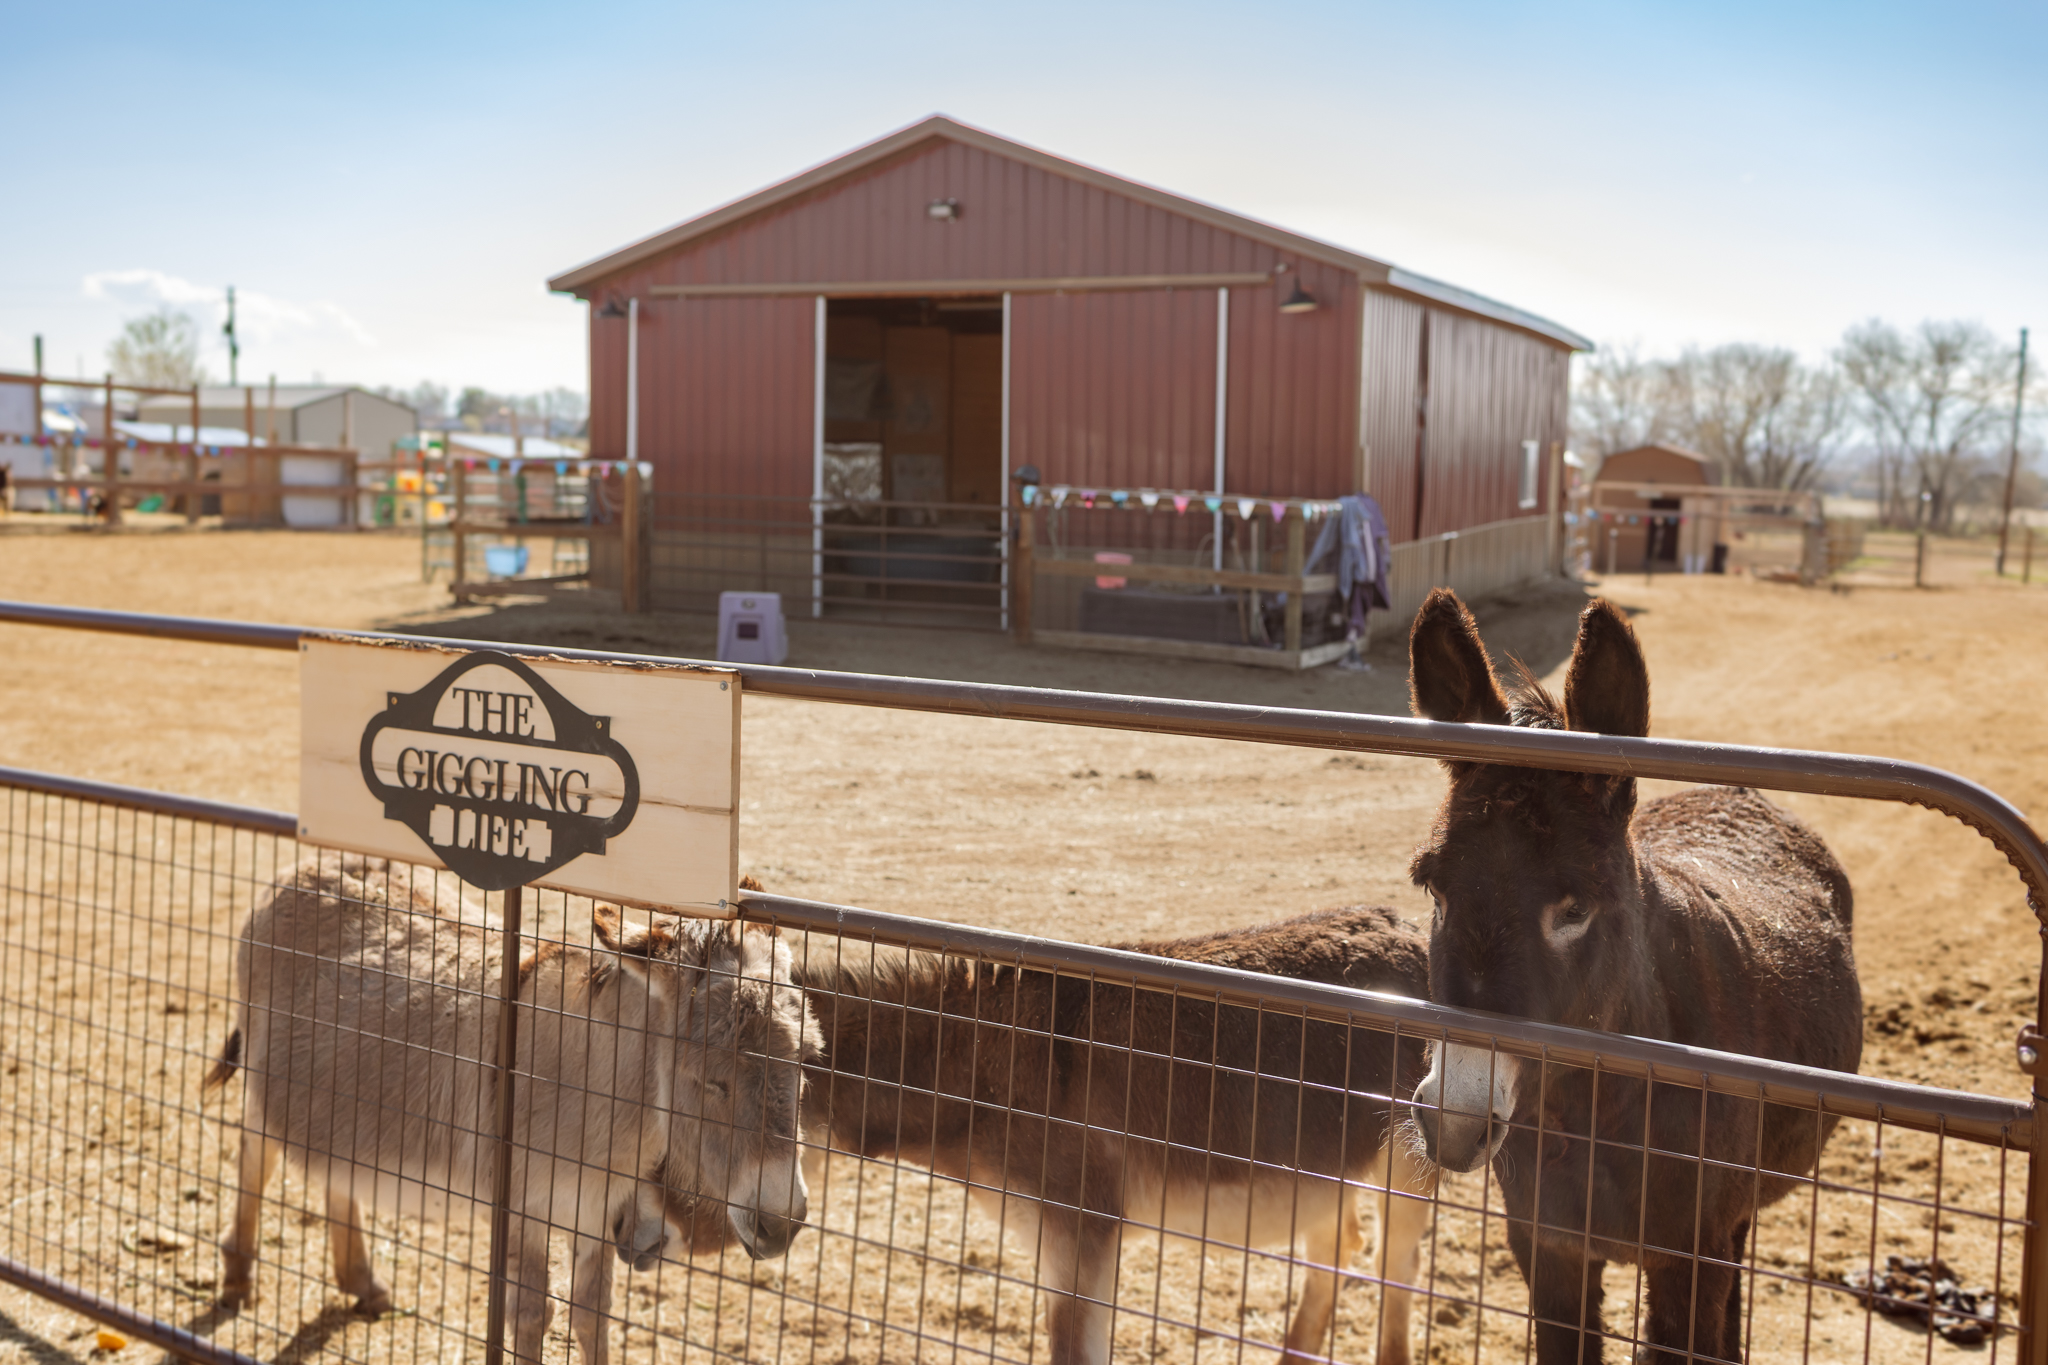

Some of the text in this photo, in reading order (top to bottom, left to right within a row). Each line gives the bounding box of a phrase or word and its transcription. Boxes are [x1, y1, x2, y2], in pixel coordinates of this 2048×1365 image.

[452, 687, 536, 738] THE
[397, 747, 591, 815] GIGGLING
[450, 807, 530, 858] LIFE
